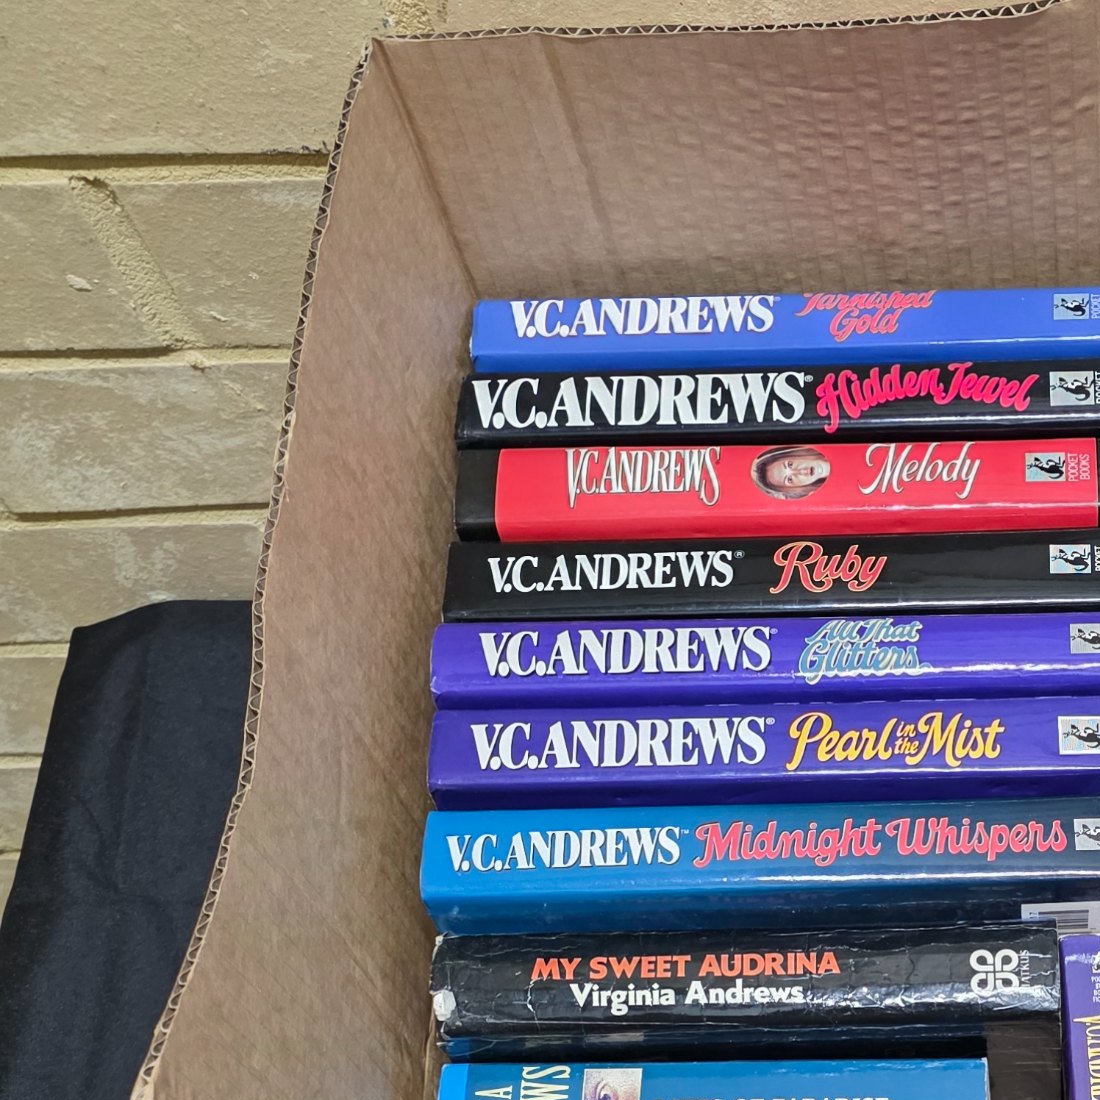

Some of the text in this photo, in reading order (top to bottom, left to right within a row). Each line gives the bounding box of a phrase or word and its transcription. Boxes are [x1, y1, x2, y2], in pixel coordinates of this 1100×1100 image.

[795, 289, 937, 316] Tarnished
[829, 306, 902, 342] Gold
[816, 363, 945, 434] Hidden
[934, 361, 1040, 412] Jewel
[858, 441, 981, 500] Melody
[769, 541, 887, 594] Ruby
[804, 617, 924, 645] All That
[799, 638, 925, 685] Glitters
[786, 711, 900, 771] Pearl
[894, 736, 920, 755] the
[896, 720, 918, 738] in
[904, 711, 1005, 767] Mist
[693, 817, 883, 869] Midnight
[885, 817, 1068, 862] Whispers
[531, 951, 841, 981] MY SWEET AUDRINA
[569, 978, 805, 1017] Virginia Andrews
